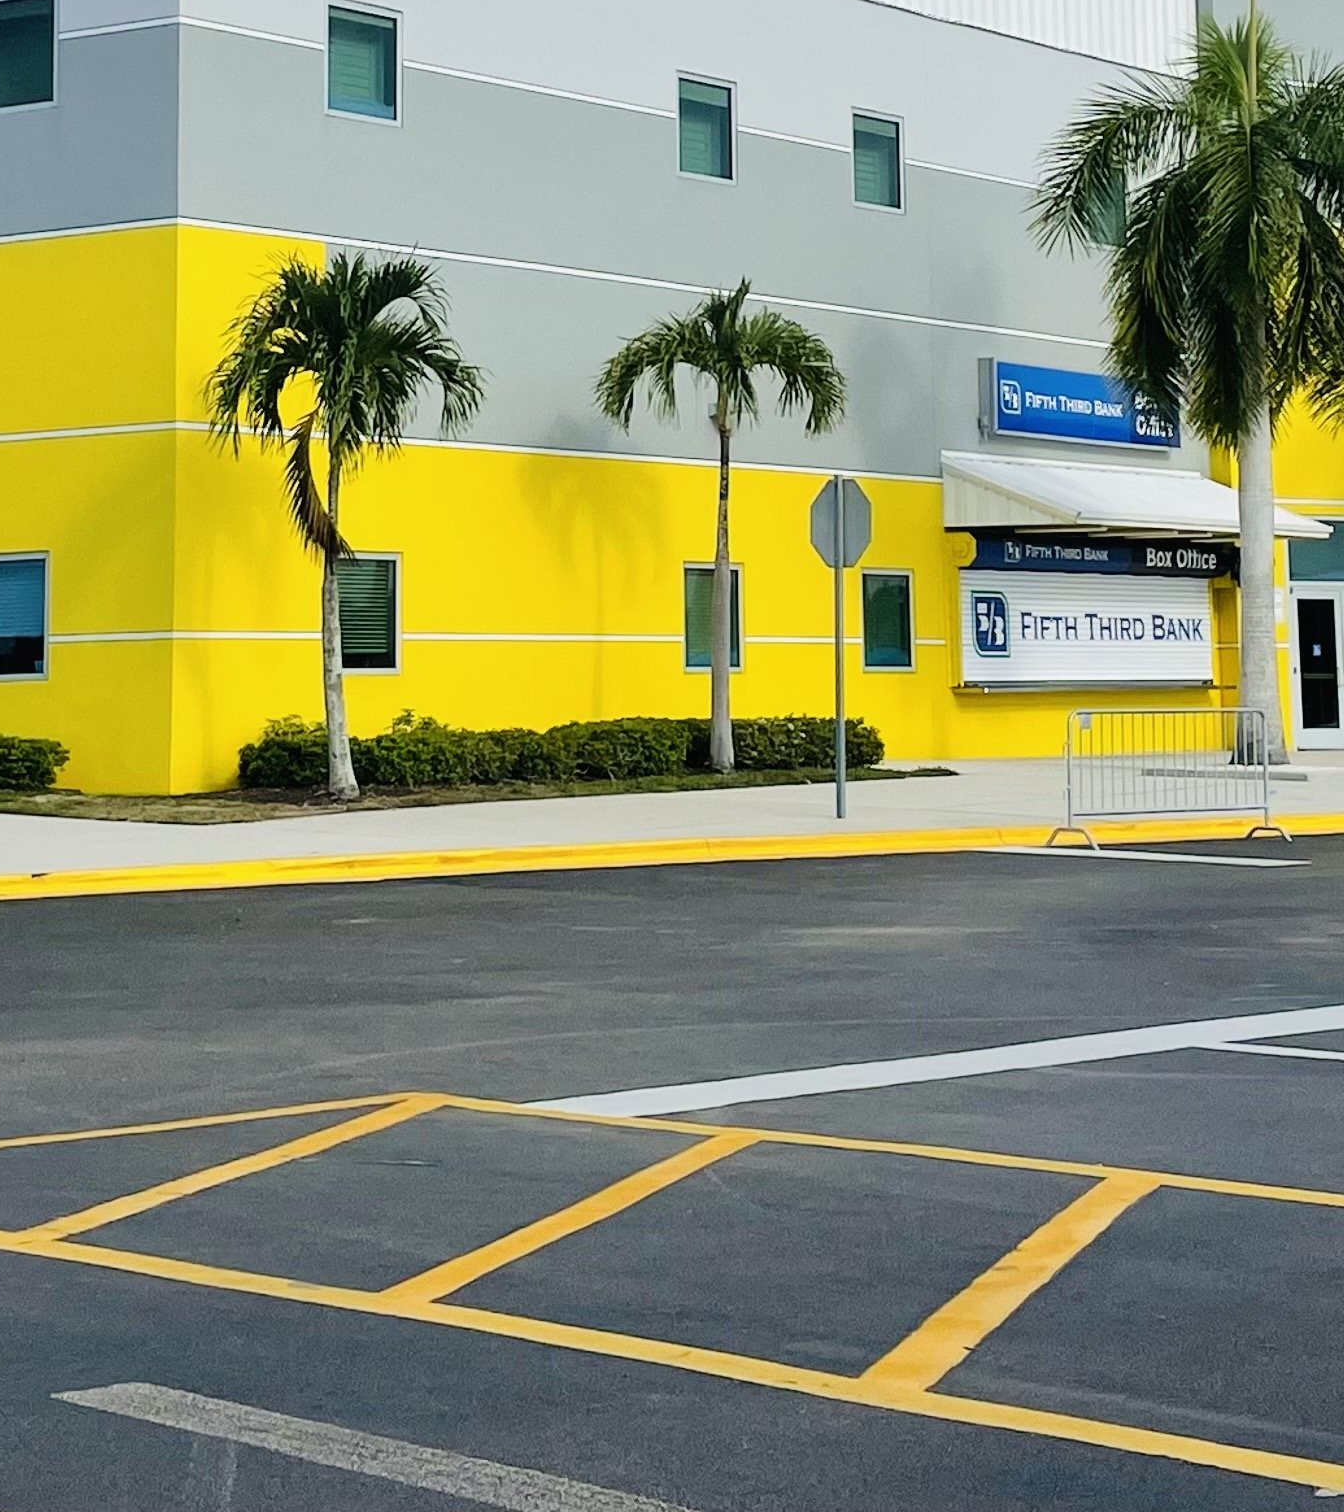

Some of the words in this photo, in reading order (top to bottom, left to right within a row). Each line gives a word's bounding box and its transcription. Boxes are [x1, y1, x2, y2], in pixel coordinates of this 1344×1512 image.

[1025, 391, 1056, 410] FIFTH
[1059, 395, 1092, 414] THIRD
[1094, 400, 1124, 418] BANK
[1025, 545, 1052, 558] FIFTH
[1054, 546, 1082, 560] THIRD
[1084, 548, 1108, 561] BANK
[1146, 548, 1172, 568] Box
[1176, 549, 1217, 570] Office
[1020, 612, 1077, 641] FIFTH
[1085, 613, 1144, 641] THIRD
[1152, 614, 1203, 641] BANK
